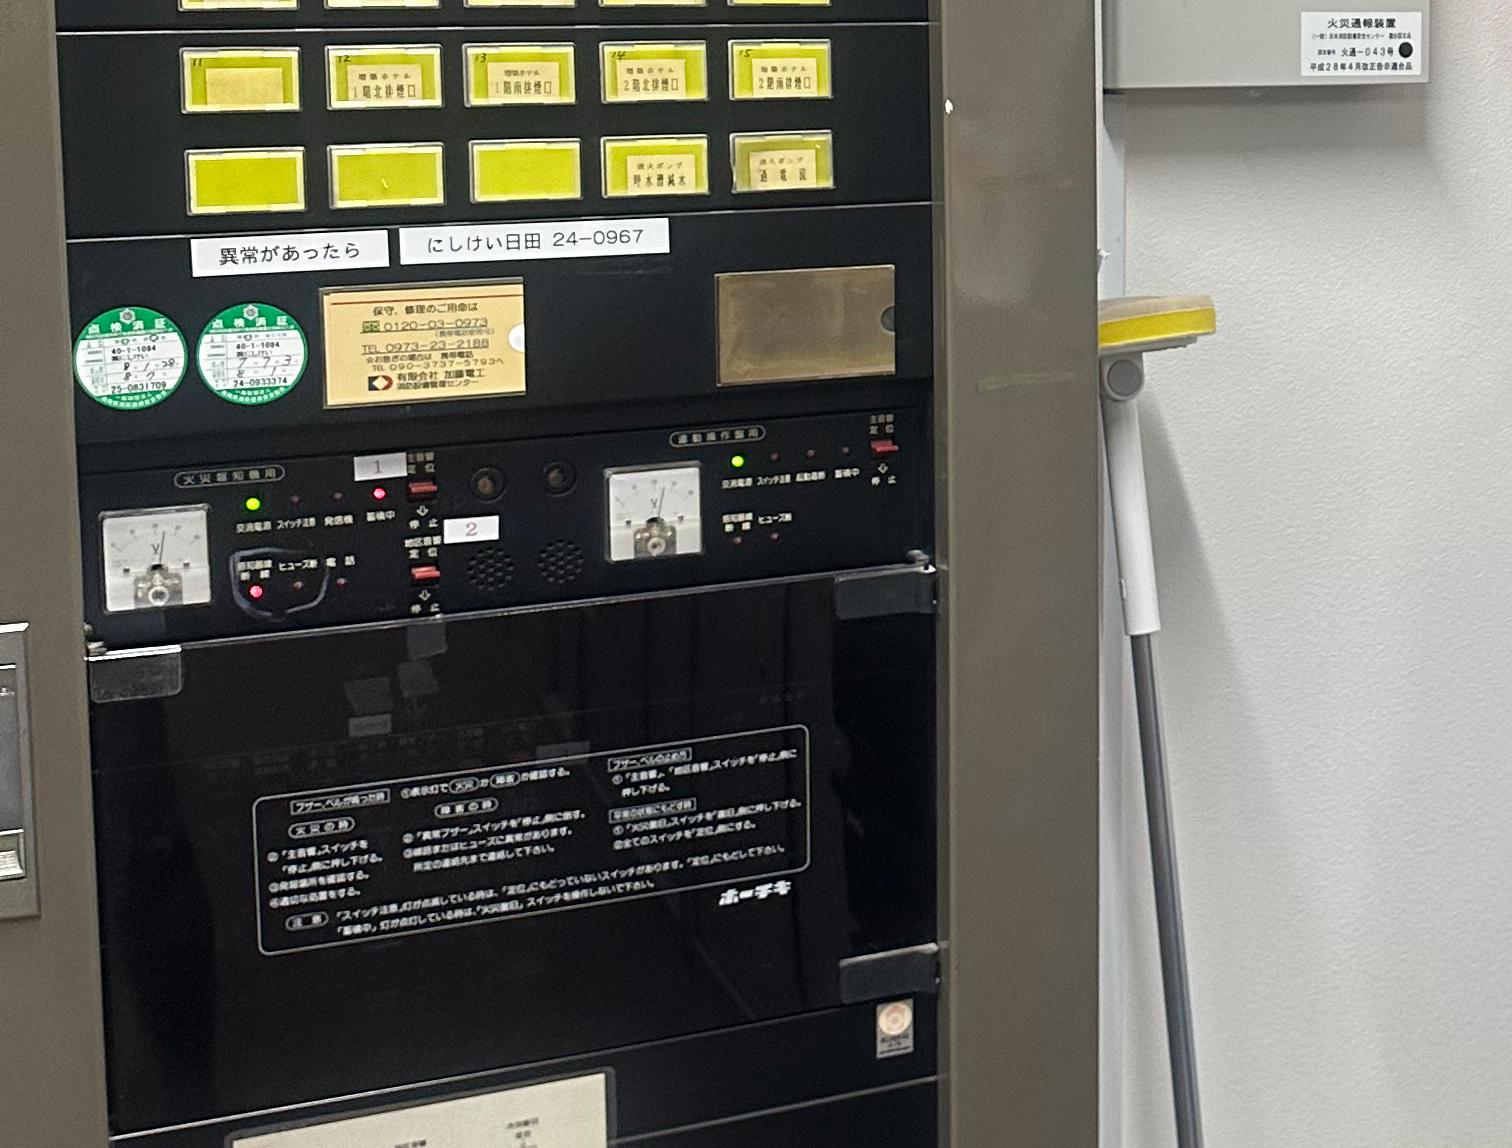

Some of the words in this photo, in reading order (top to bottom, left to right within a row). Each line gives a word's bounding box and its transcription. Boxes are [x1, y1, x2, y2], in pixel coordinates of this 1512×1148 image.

[1327, 17, 1397, 29] 火災通報装置
[495, 80, 553, 96] 1階南排煙口
[622, 78, 680, 93] 2階北排煙口
[757, 76, 812, 91] 2階南排煙口
[352, 84, 418, 99] 1階北排煙口
[427, 231, 542, 254] にしけい日田
[551, 228, 645, 248] 24-0967
[218, 242, 361, 267] 異常があったら
[373, 302, 478, 317] 保守、修理のご用命は
[384, 317, 489, 331] 0120-03-0973
[361, 344, 380, 354] TEL
[385, 338, 490, 352] 0973-23-2188
[397, 370, 439, 382] 有限会社
[444, 368, 486, 380] 加藤電工
[465, 521, 478, 537] 2
[718, 879, 793, 907] ホーチキ
